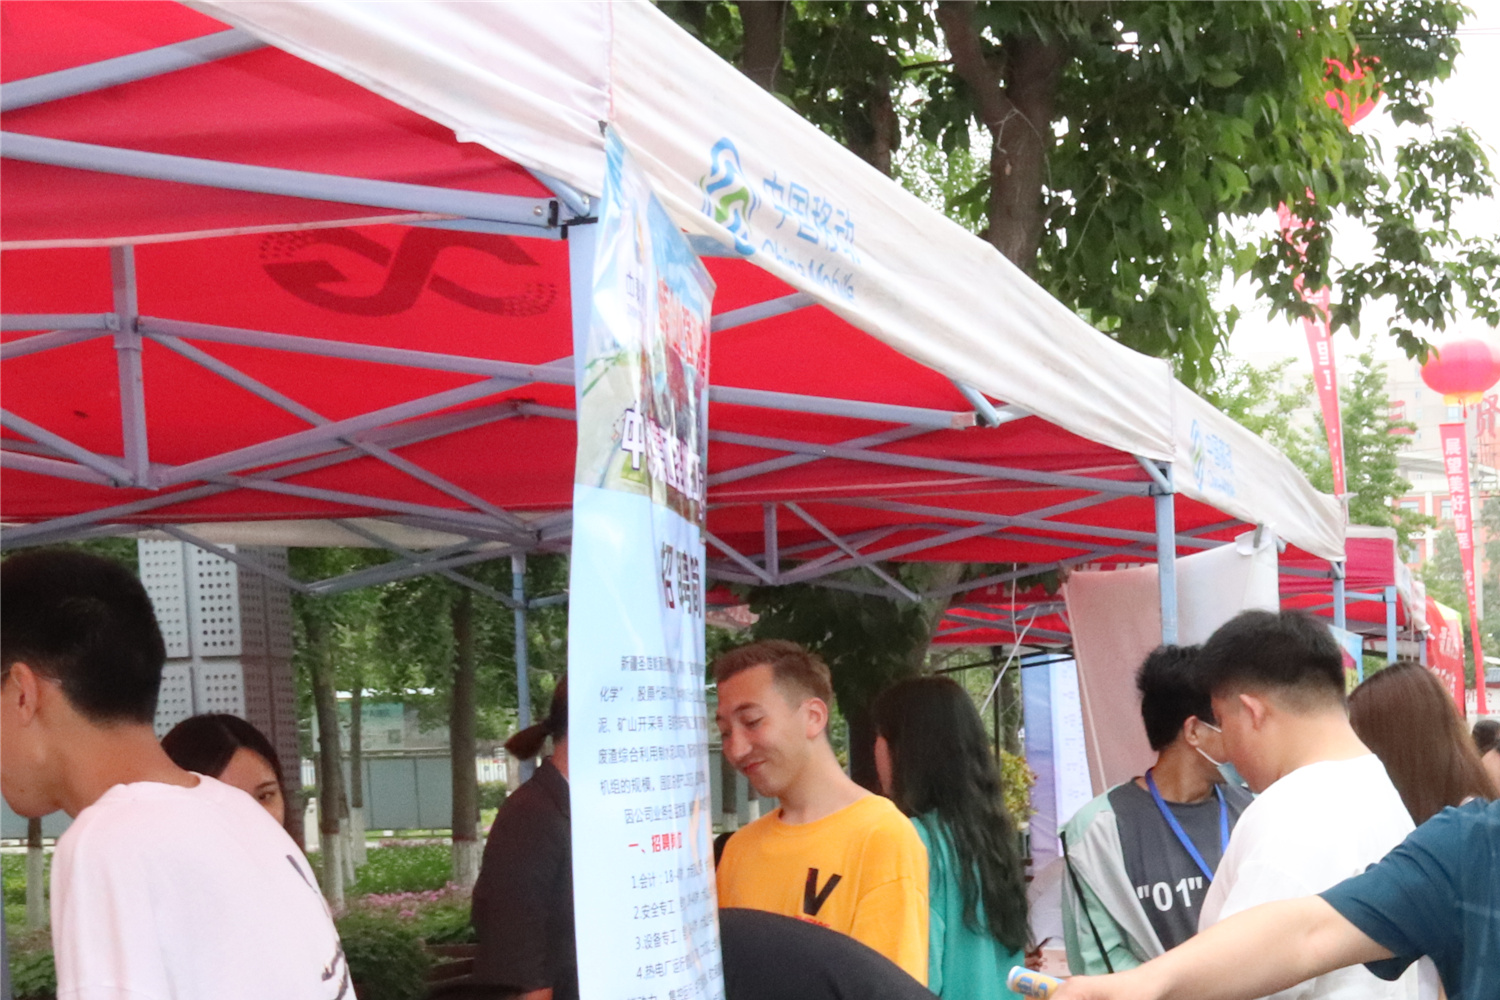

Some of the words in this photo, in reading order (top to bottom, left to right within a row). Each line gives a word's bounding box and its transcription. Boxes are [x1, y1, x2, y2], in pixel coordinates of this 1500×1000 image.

[763, 171, 860, 263] 中国移动
[803, 867, 843, 917] V
